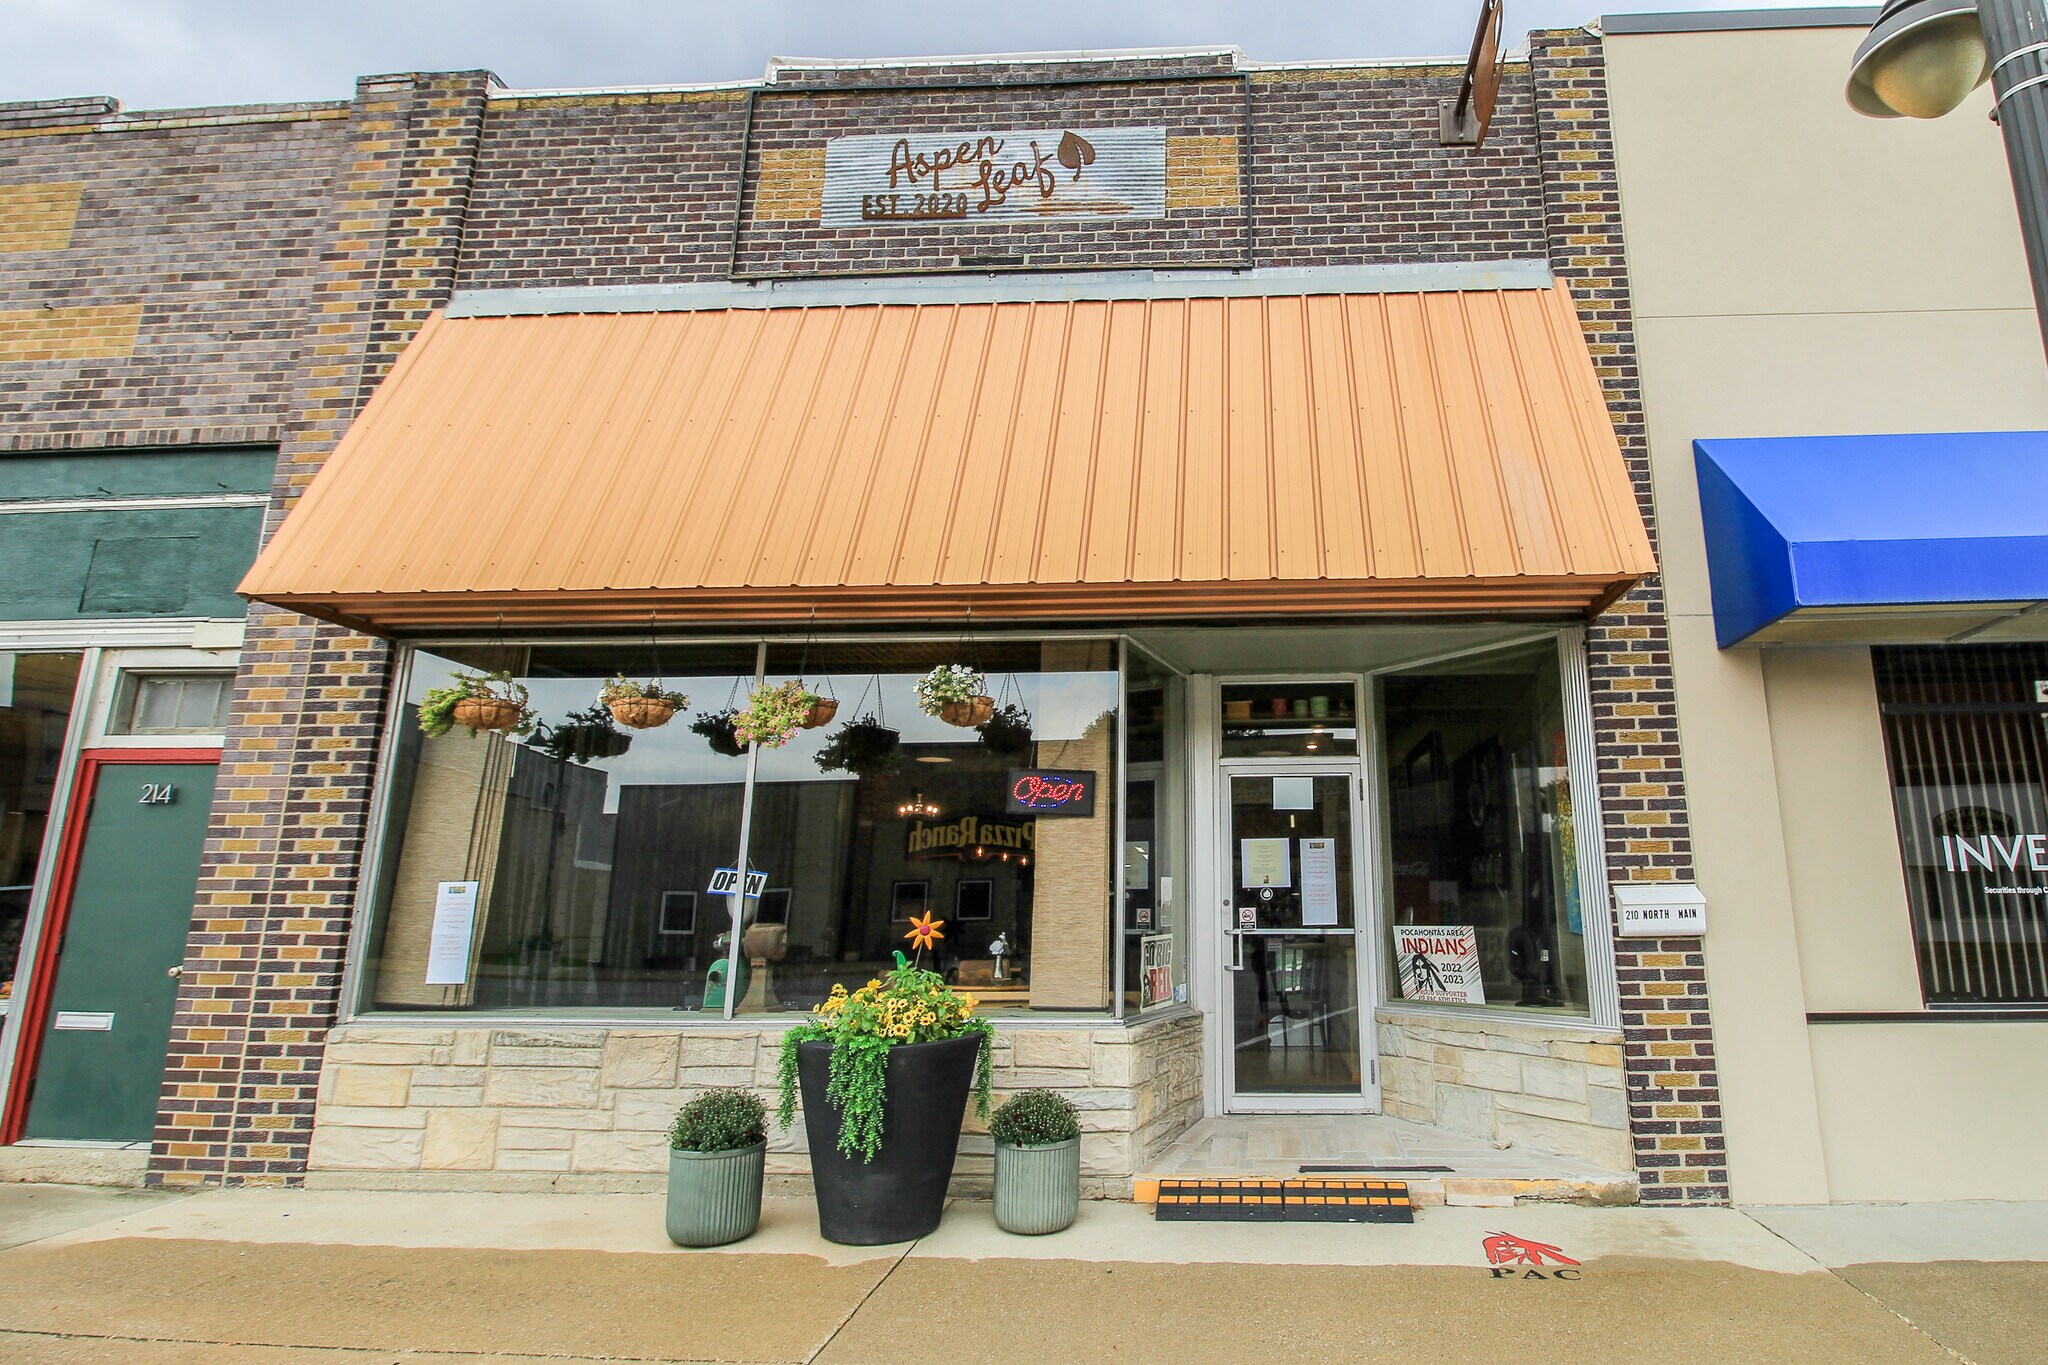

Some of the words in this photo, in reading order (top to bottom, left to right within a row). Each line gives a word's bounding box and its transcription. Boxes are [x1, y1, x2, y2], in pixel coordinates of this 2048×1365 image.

[885, 136, 1005, 191] Aspen
[972, 140, 1055, 212] Leaf
[138, 783, 172, 804] 214
[1013, 776, 1084, 807] Open
[1983, 886, 2016, 894] Securities
[2016, 886, 2043, 895] through
[1625, 910, 1639, 920] 210
[1643, 909, 1670, 920] NORTH
[1678, 908, 1697, 919] MAIN
[1401, 929, 1445, 937] POCAHONTAS
[1446, 929, 1464, 937] AREA
[1156, 940, 1171, 967] BIG
[1402, 938, 1467, 956] INDIANS
[1441, 963, 1462, 972] 2022
[1443, 975, 1464, 984] 2023
[1435, 990, 1468, 998] SUPPORTER
[1486, 1268, 1582, 1281] PAC
